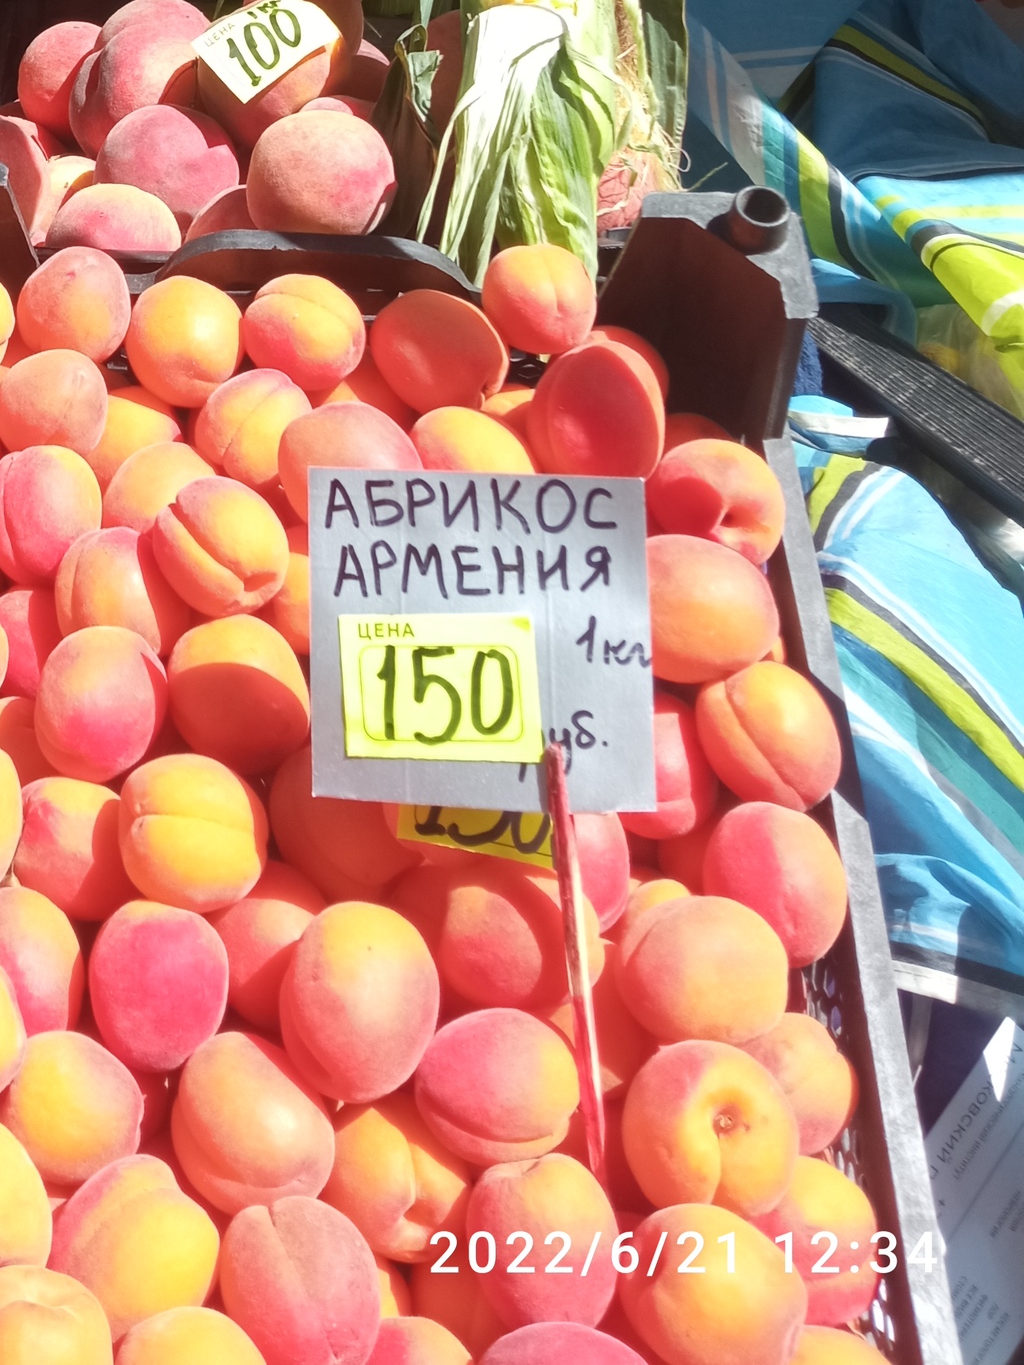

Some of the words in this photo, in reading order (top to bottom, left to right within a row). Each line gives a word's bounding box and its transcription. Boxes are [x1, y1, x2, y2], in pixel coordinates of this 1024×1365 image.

[204, 23, 235, 48] ЦЕНА
[226, 8, 302, 87] 100
[324, 478, 618, 534] АБРИКОС
[333, 540, 612, 599] АРМЕНИЯ
[357, 622, 415, 639] ЦЕНА
[377, 644, 515, 746] 150
